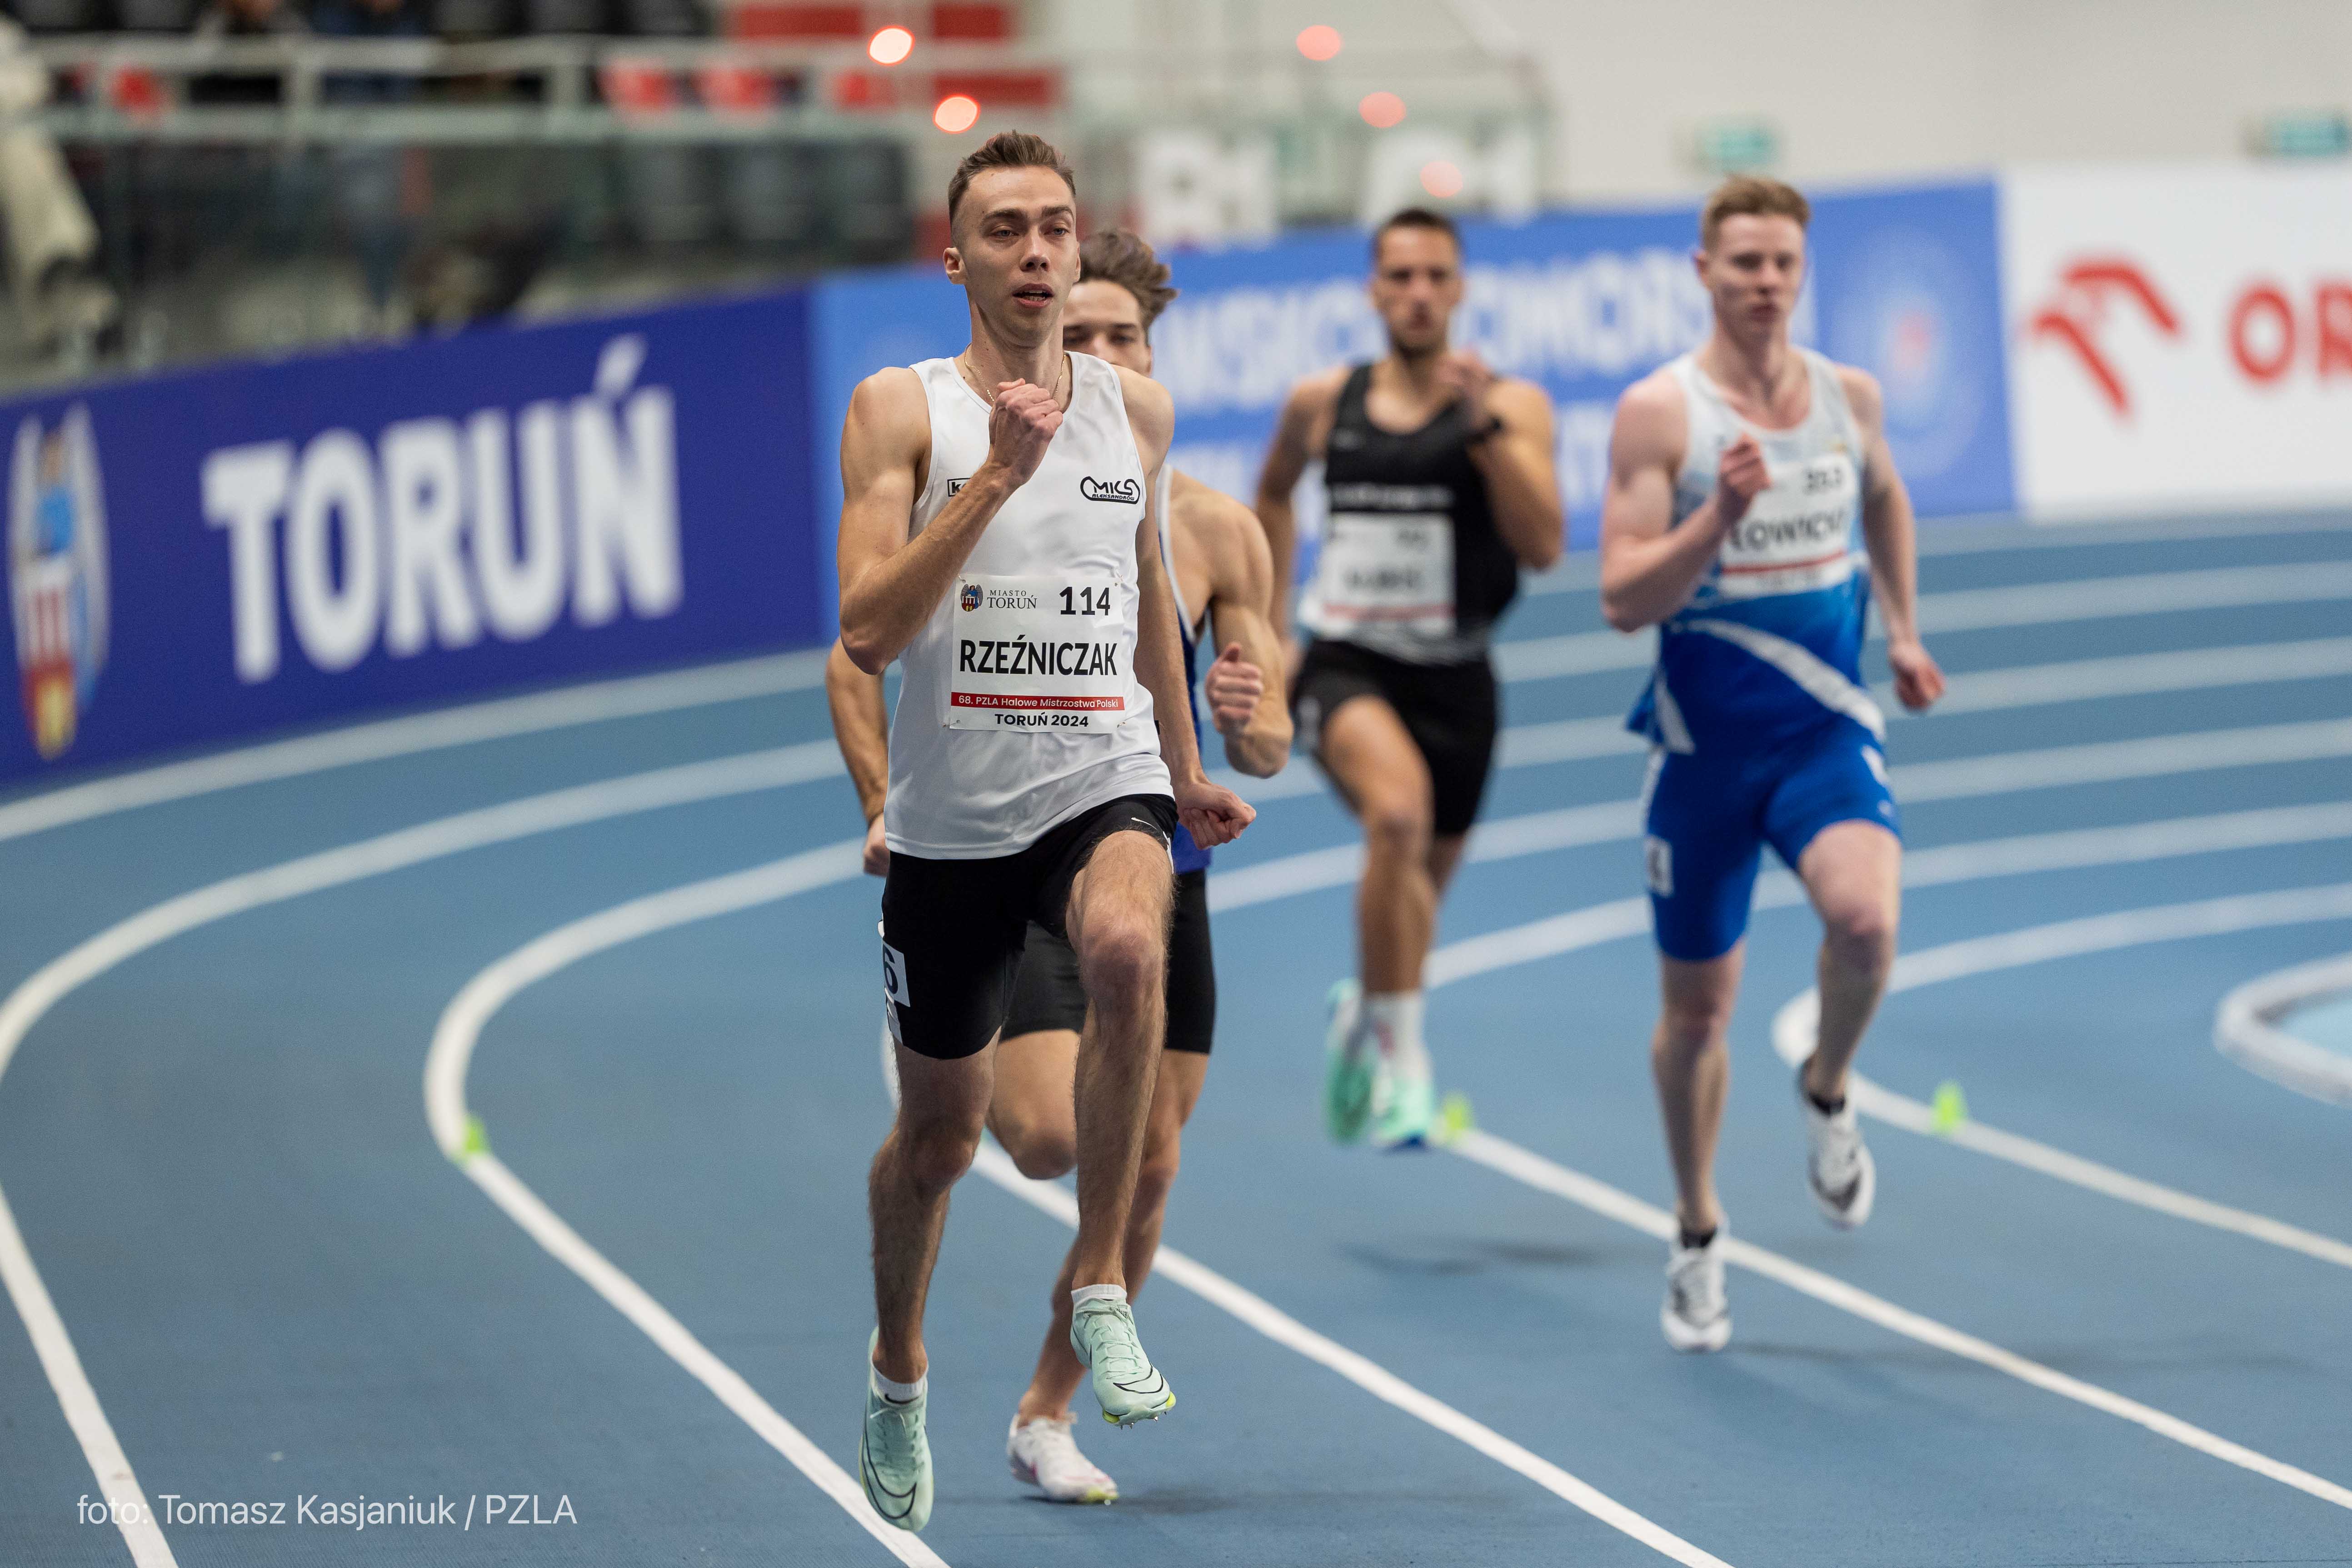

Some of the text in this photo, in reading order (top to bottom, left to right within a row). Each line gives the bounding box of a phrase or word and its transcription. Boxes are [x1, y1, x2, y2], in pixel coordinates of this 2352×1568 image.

[201, 334, 678, 683] TORUŃ
[987, 595, 1037, 609] TORUŃ
[1059, 586, 1110, 615] 114
[960, 634, 1118, 675] RZEŹNICZAK
[959, 695, 1119, 708] 68. PZLA Halowe Mistrzostwa Polski
[994, 711, 1089, 727] TORUŃ 2024
